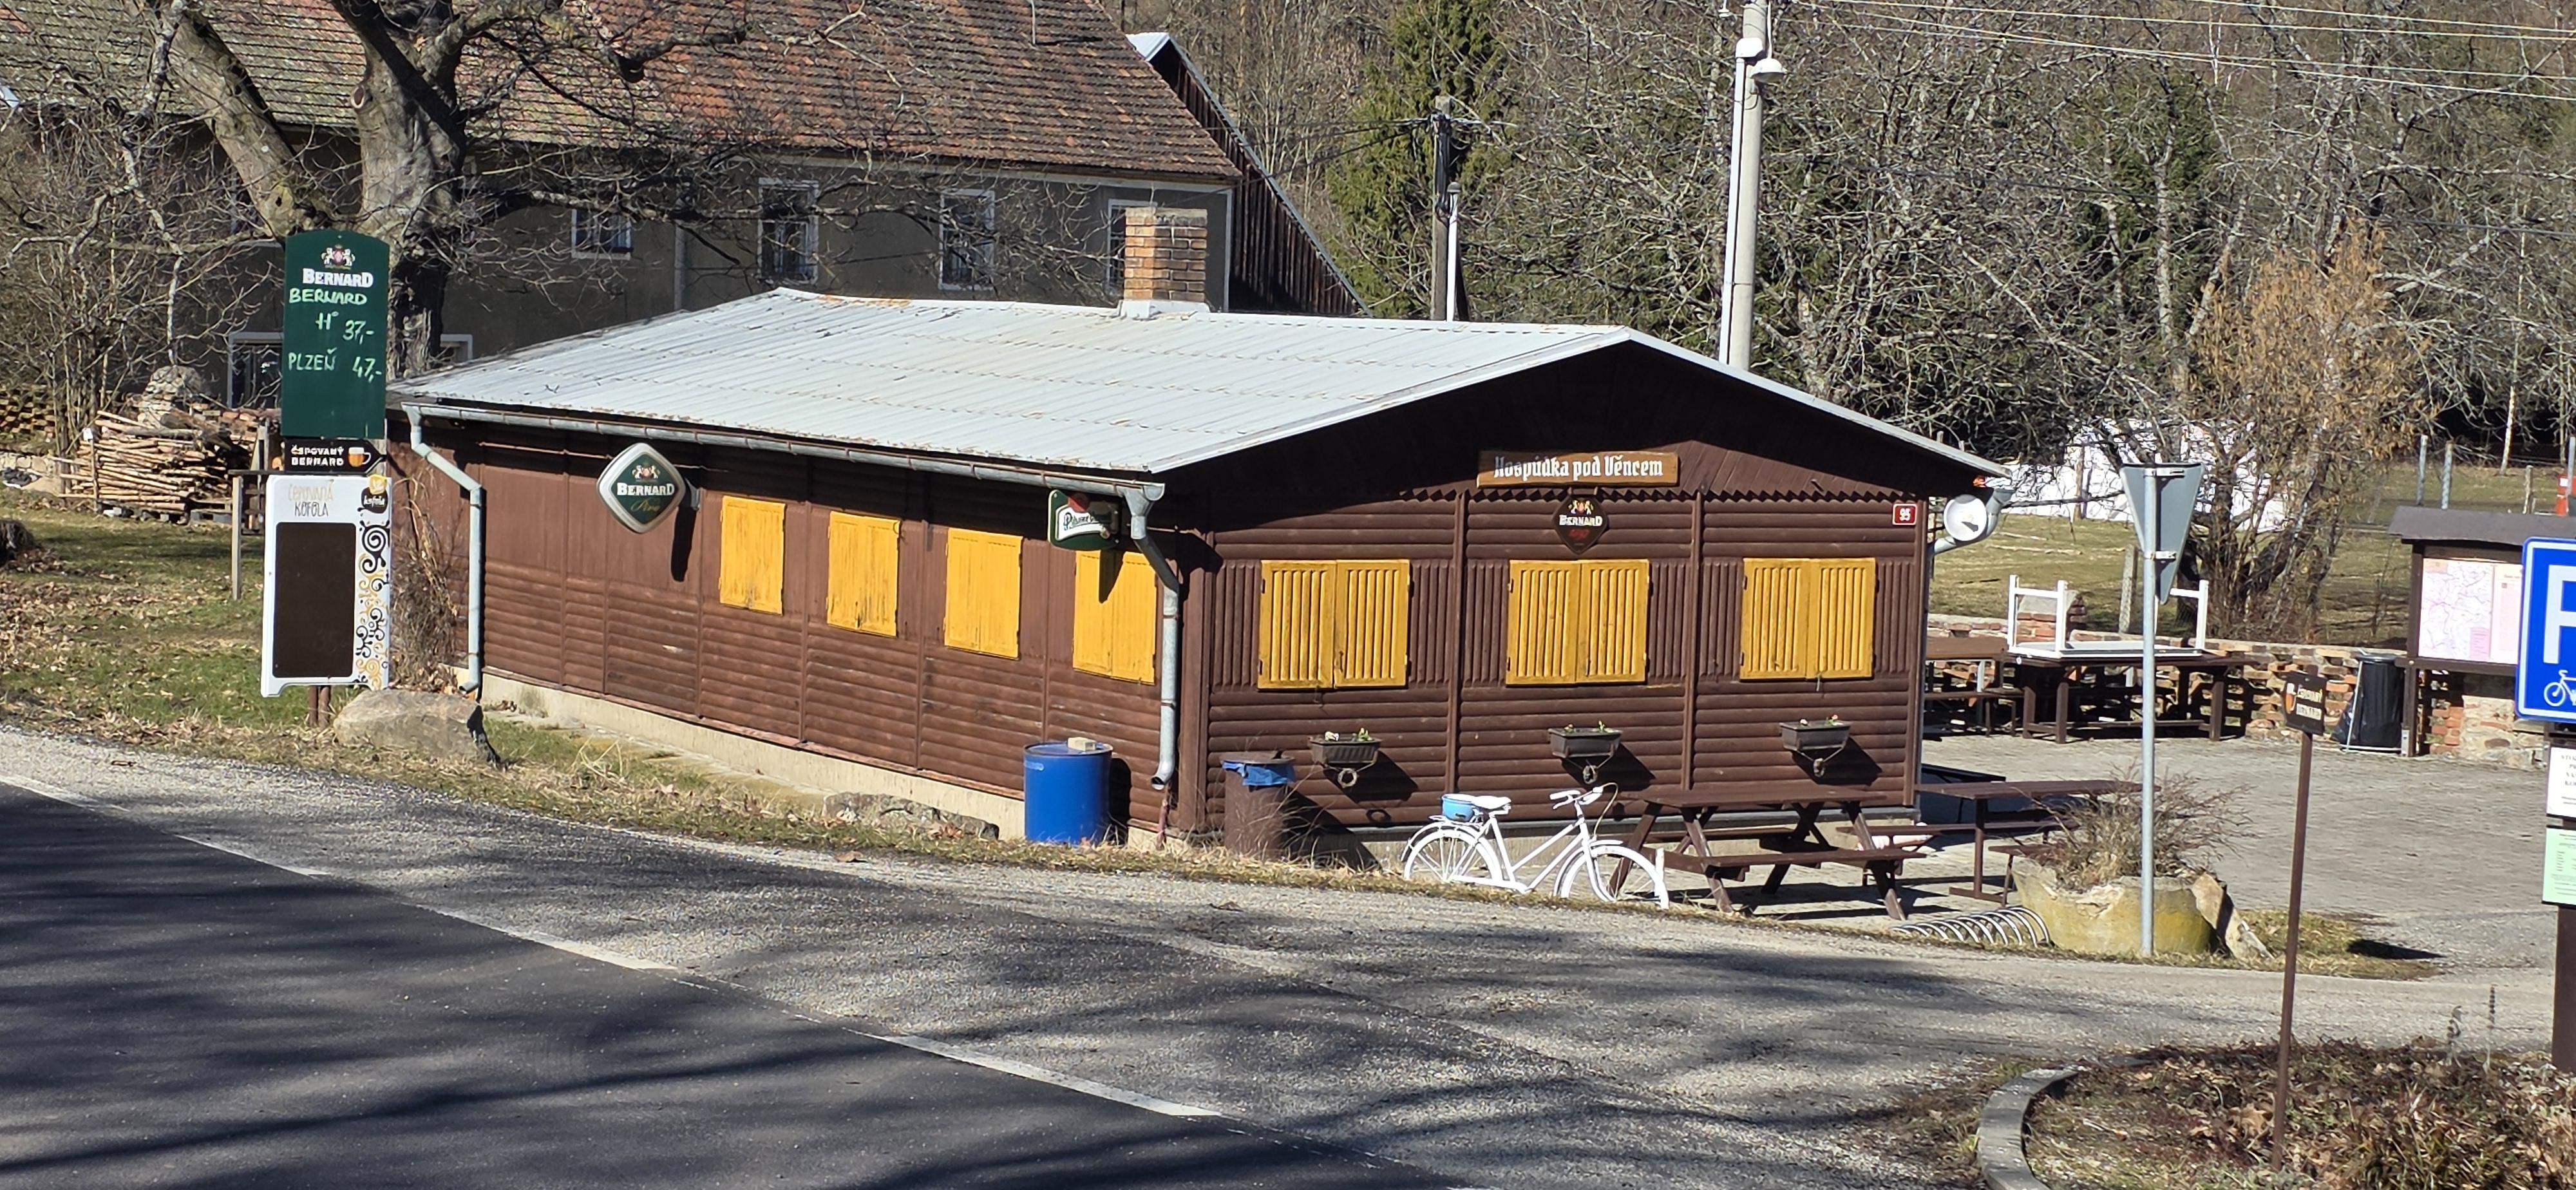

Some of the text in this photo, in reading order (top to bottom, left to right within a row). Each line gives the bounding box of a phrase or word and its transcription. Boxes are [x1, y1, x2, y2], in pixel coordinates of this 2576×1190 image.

[303, 268, 374, 288] BERNARD
[289, 288, 367, 305] BERNARD
[289, 347, 337, 371] PLZEŇ
[291, 457, 344, 467] BERNARD
[1573, 456, 1601, 481] pod
[1604, 455, 1663, 477] Věncem
[616, 482, 675, 496] BERNARD
[294, 502, 329, 518] KOFOLA
[1559, 515, 1603, 527] BERNARD
